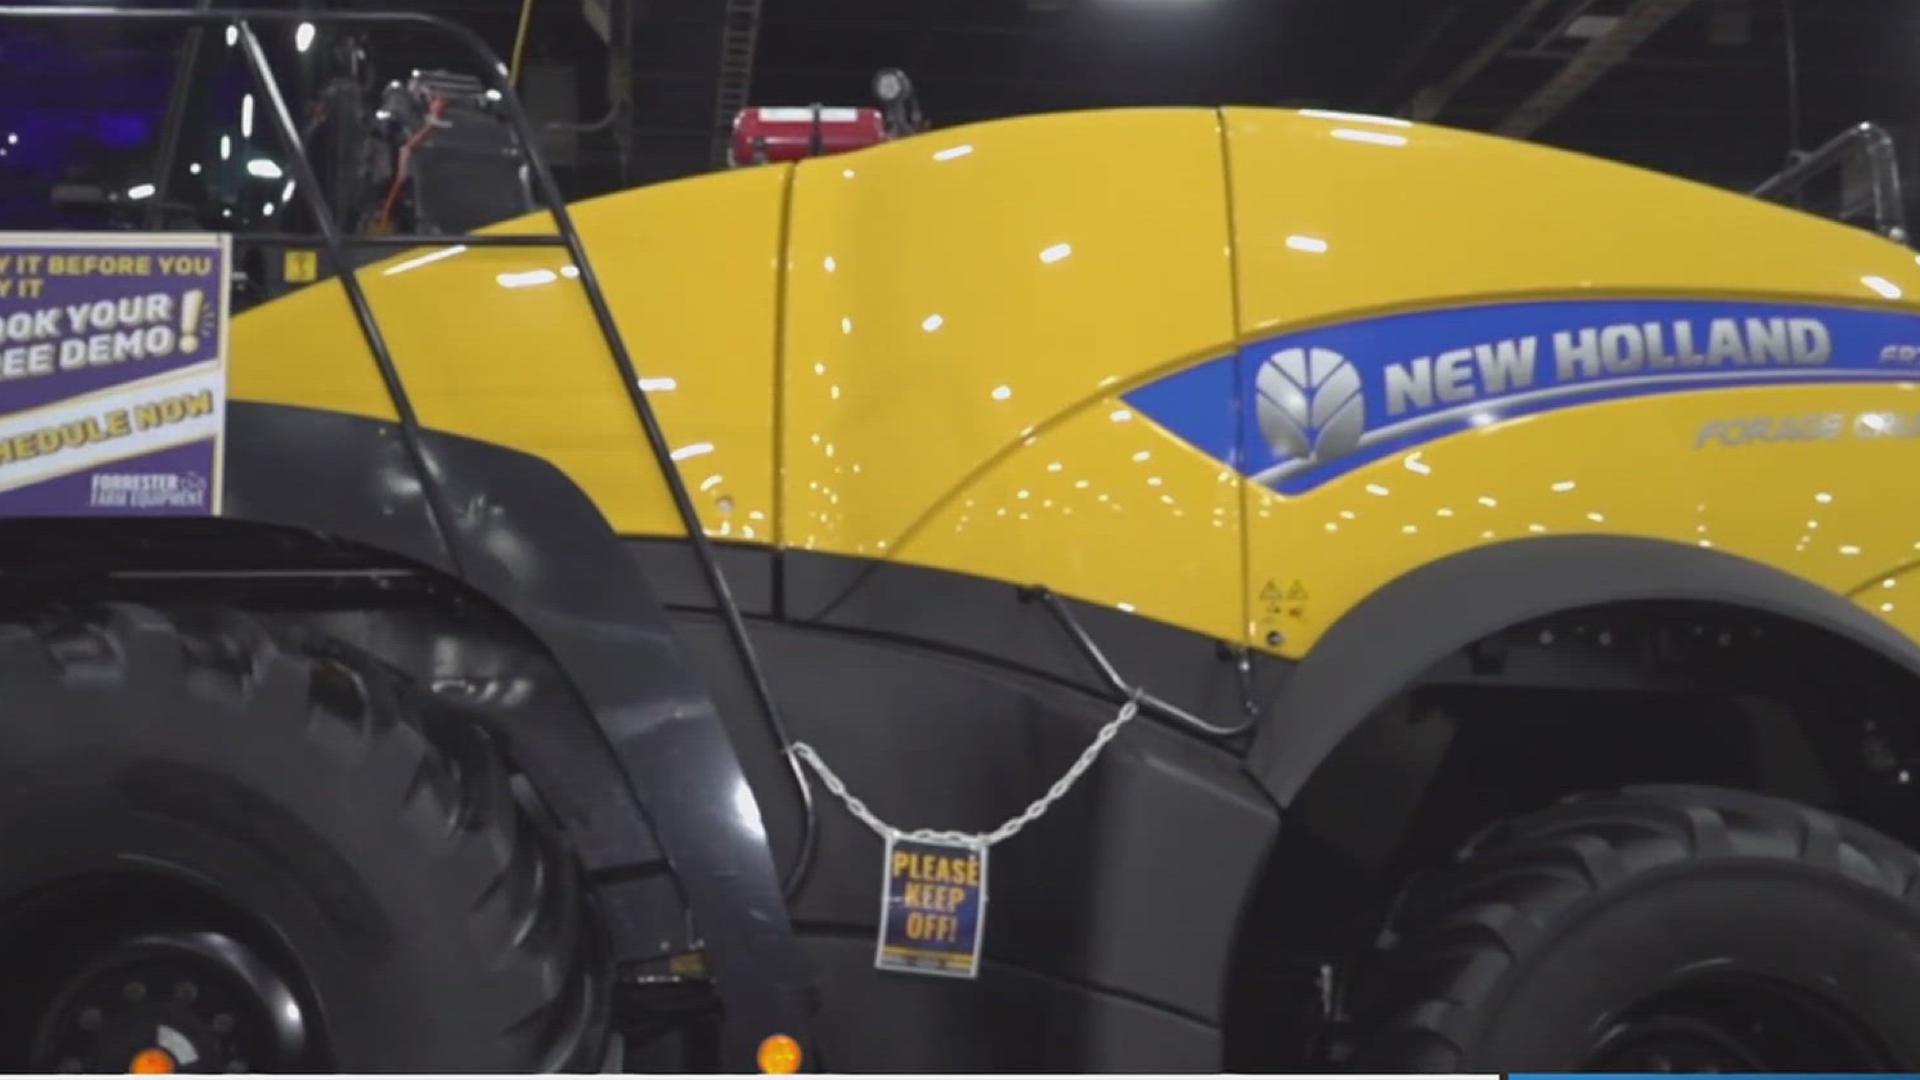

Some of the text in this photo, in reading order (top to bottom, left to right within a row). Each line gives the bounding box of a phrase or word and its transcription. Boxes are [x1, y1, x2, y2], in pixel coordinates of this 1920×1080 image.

[17, 255, 40, 274] IT
[47, 255, 149, 275] BEFORE
[159, 255, 211, 275] YOU
[18, 278, 43, 297] IT
[0, 293, 172, 340] OK YOUR
[59, 325, 173, 368] DEMO
[1385, 318, 1830, 415] NEW HOLLAND
[134, 390, 213, 430] NOW
[1695, 413, 1843, 448] FORAGE
[92, 473, 178, 490] FORRESTER
[893, 851, 979, 886] PLEASE
[904, 882, 965, 912] KEEP
[906, 912, 957, 942] OFF!
